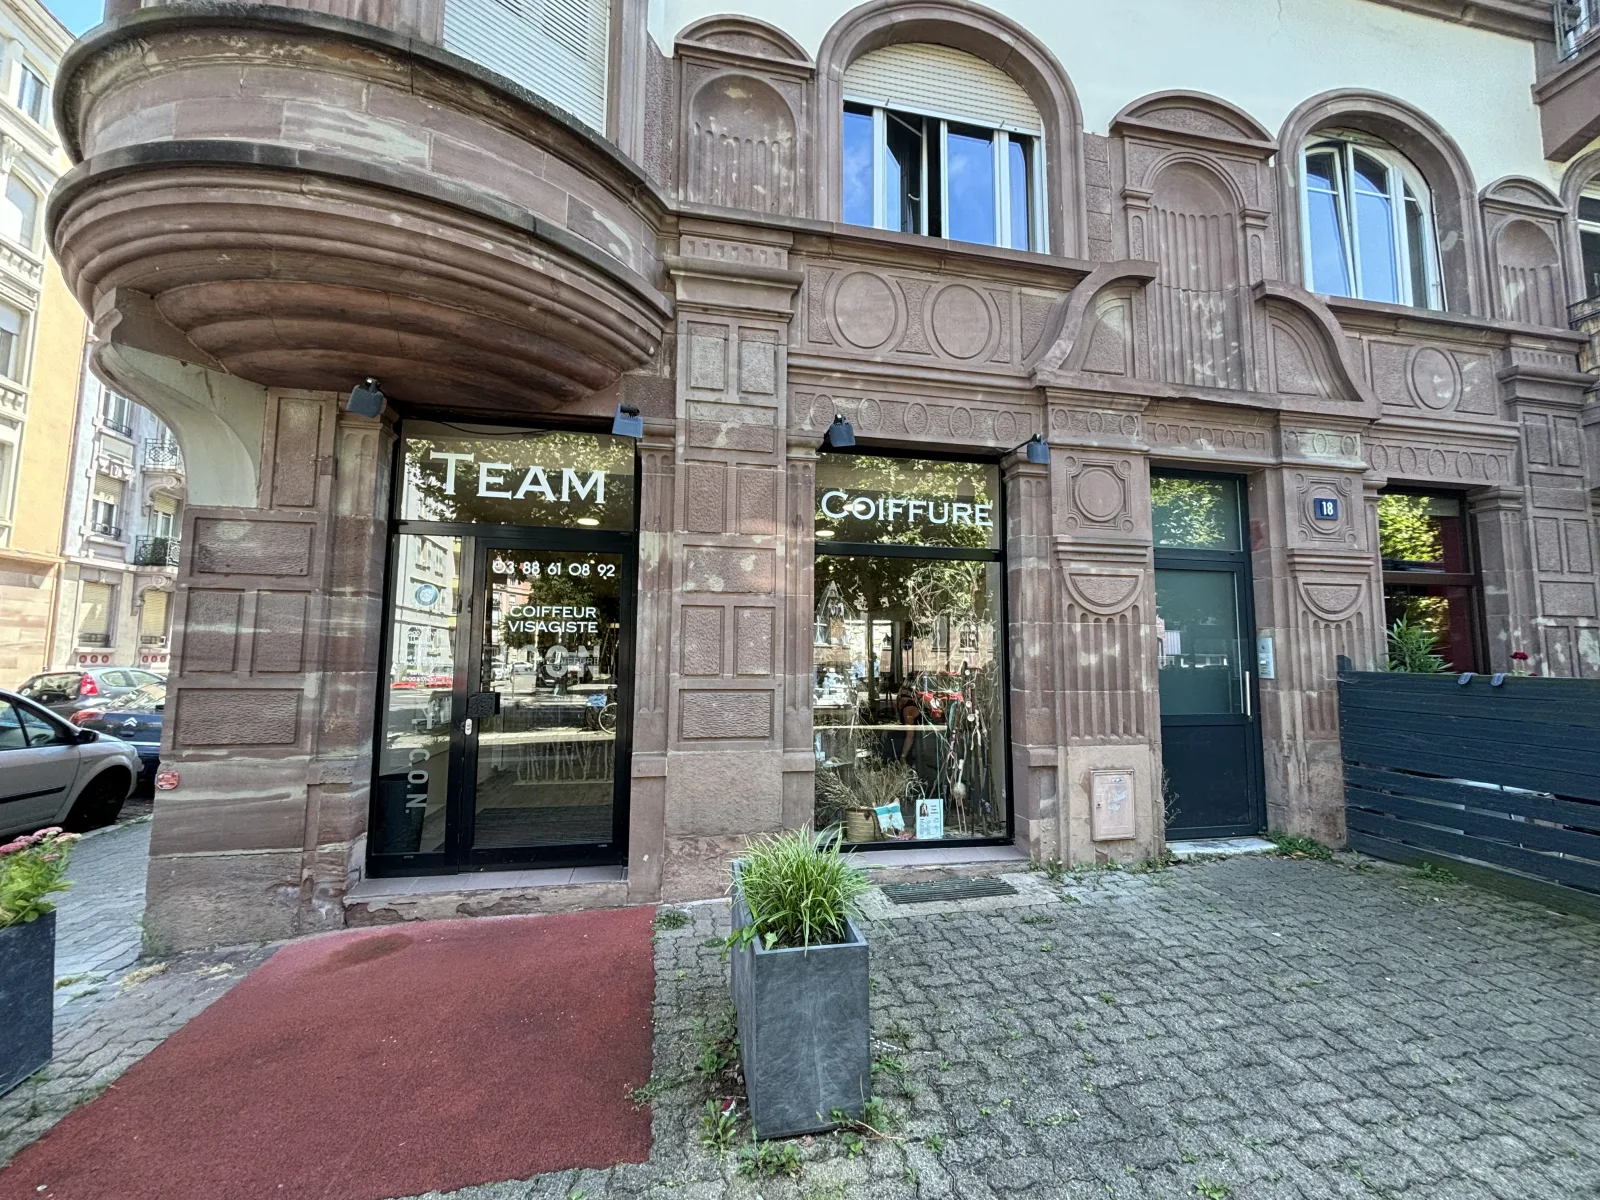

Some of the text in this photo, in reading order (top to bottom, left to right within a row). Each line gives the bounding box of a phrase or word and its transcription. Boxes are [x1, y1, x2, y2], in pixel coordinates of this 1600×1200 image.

[430, 450, 605, 504] TEAM
[821, 490, 994, 527] COIFFURE
[1321, 501, 1334, 516] 18
[492, 559, 615, 577] 03 88 61 08 92
[510, 605, 597, 618] COIFFEUR
[508, 620, 598, 633] VISAGISTE
